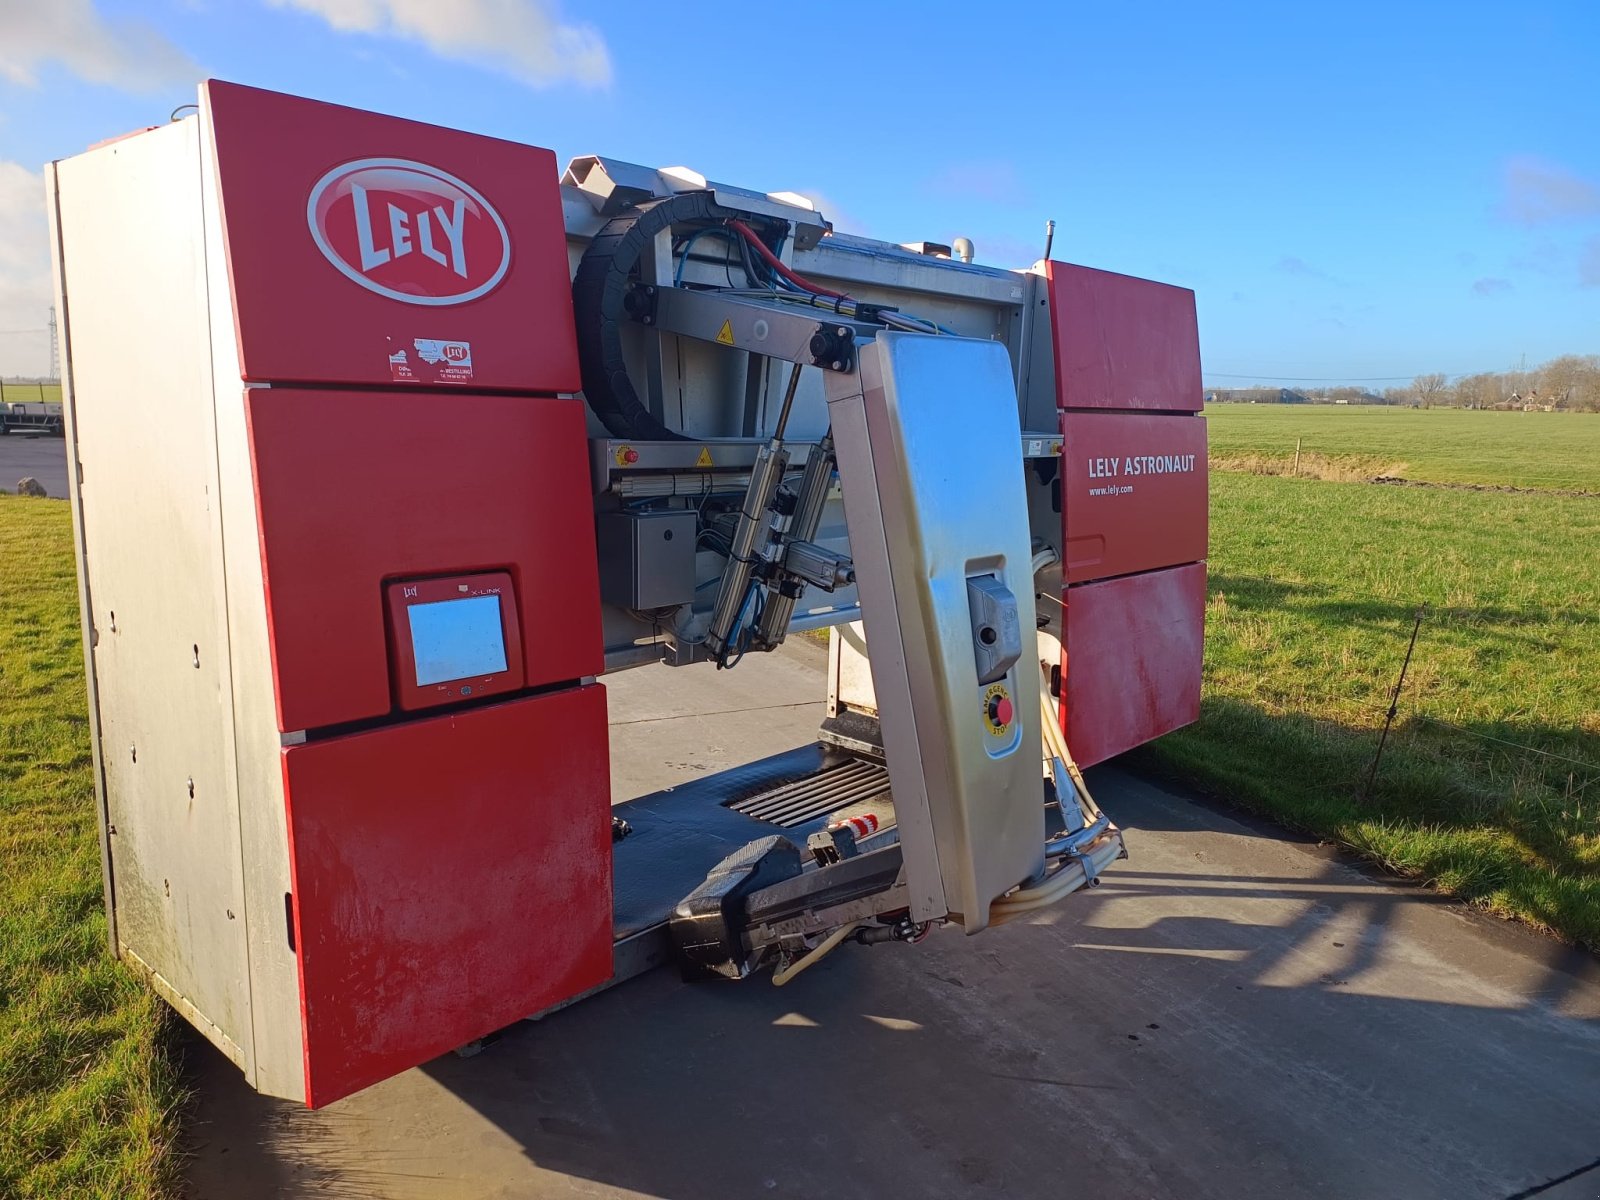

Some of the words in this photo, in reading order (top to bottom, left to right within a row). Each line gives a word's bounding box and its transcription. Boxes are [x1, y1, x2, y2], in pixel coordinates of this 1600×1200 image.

[351, 182, 468, 280] LELY
[1088, 458, 1119, 478] LELY
[1124, 455, 1195, 476] ASTRONAUT
[1088, 485, 1133, 496] www.lely.com
[983, 685, 1009, 715] EMERGENC
[992, 724, 1008, 735] STO
